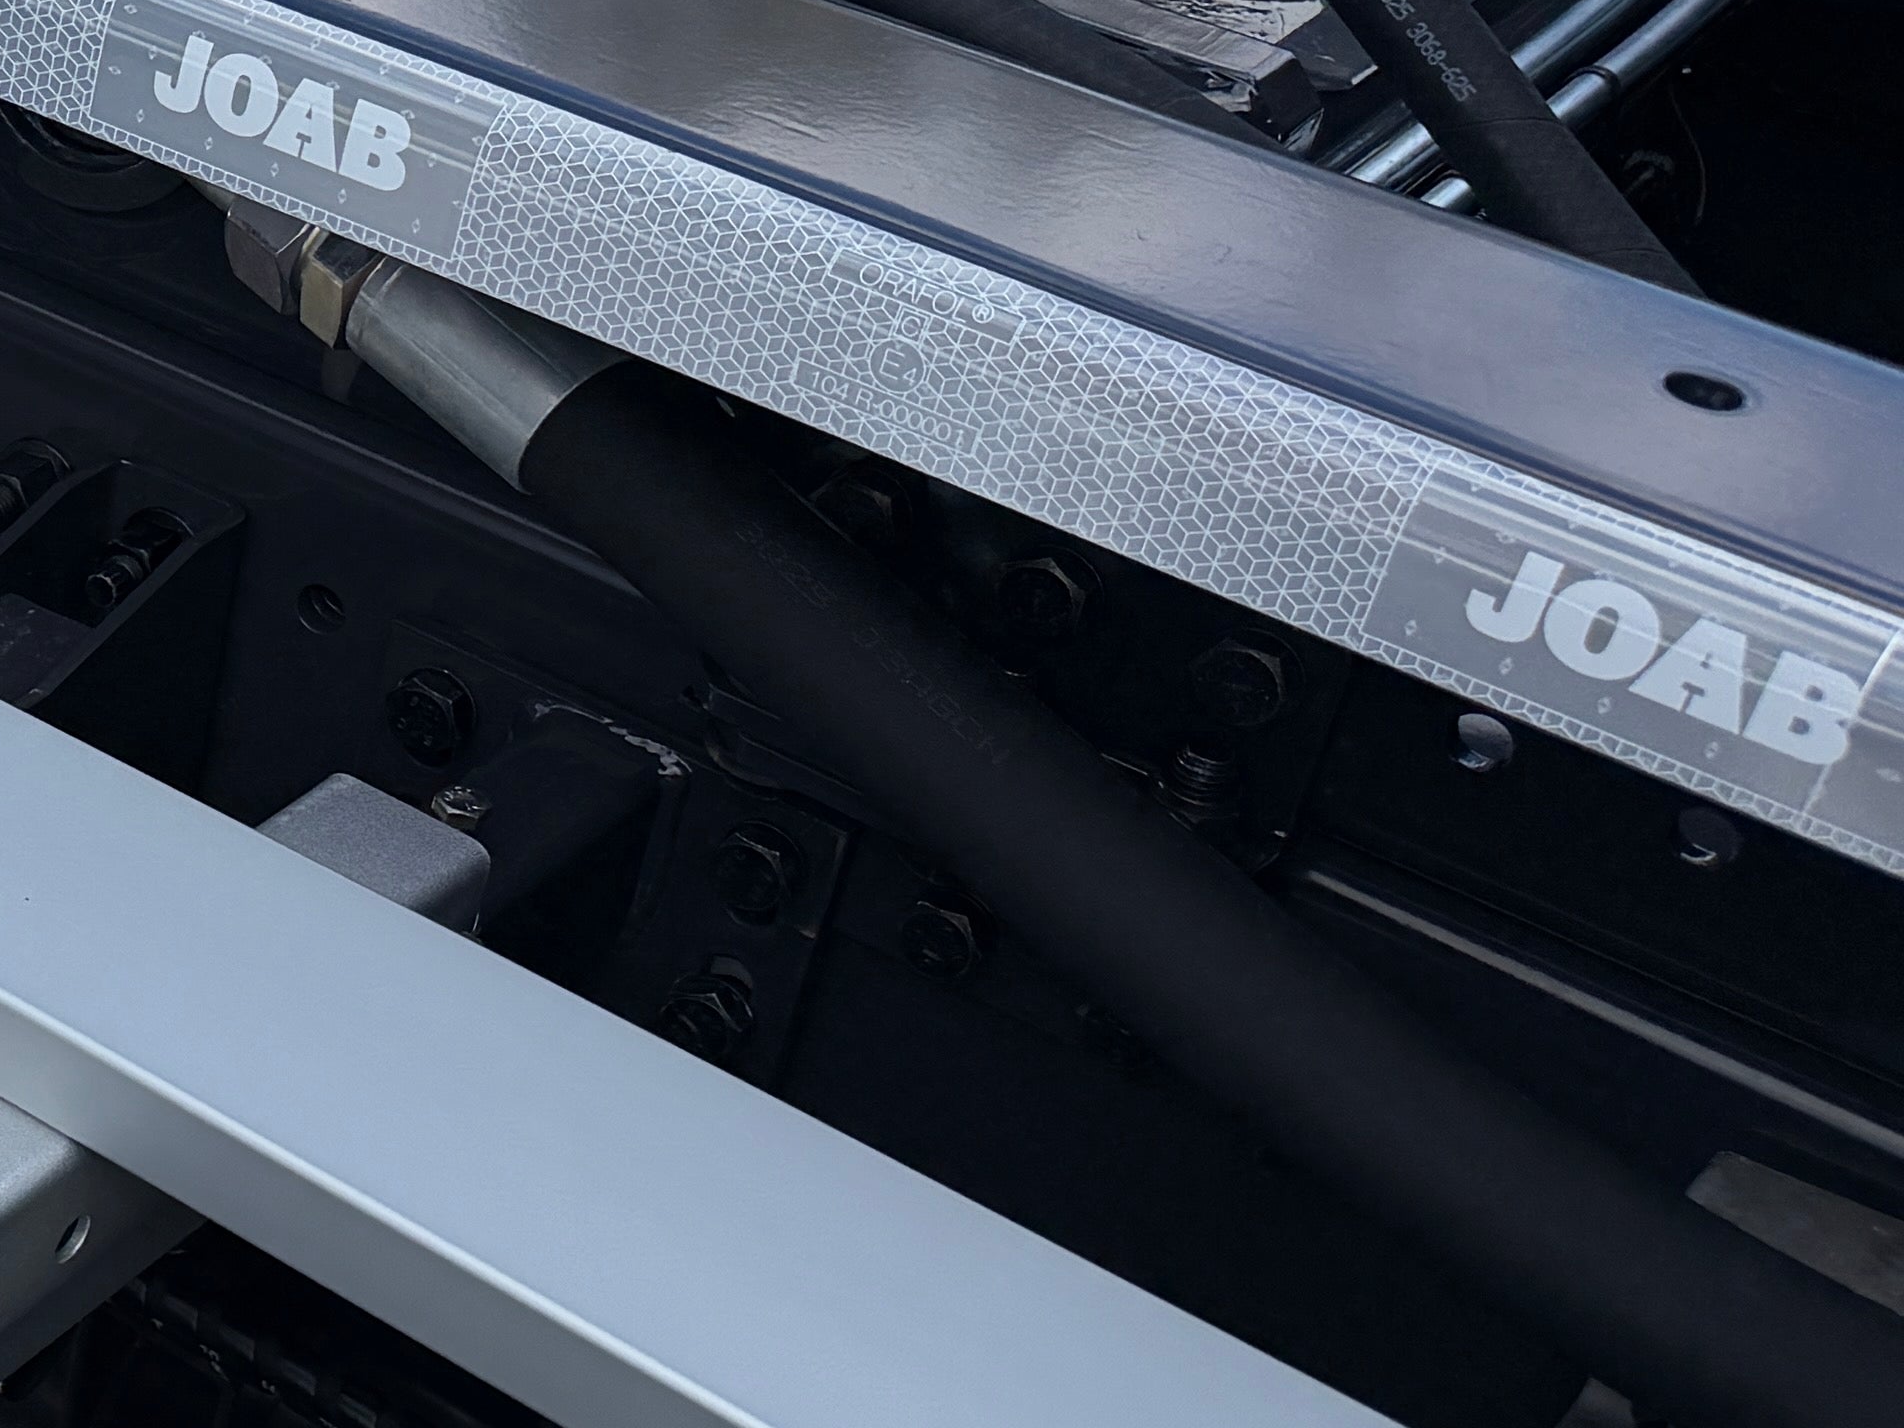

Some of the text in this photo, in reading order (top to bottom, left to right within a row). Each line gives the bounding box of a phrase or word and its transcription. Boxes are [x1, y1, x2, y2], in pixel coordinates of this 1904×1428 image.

[153, 34, 415, 193] JOAB
[810, 369, 850, 401] 104
[1465, 550, 1866, 767] JOAB
